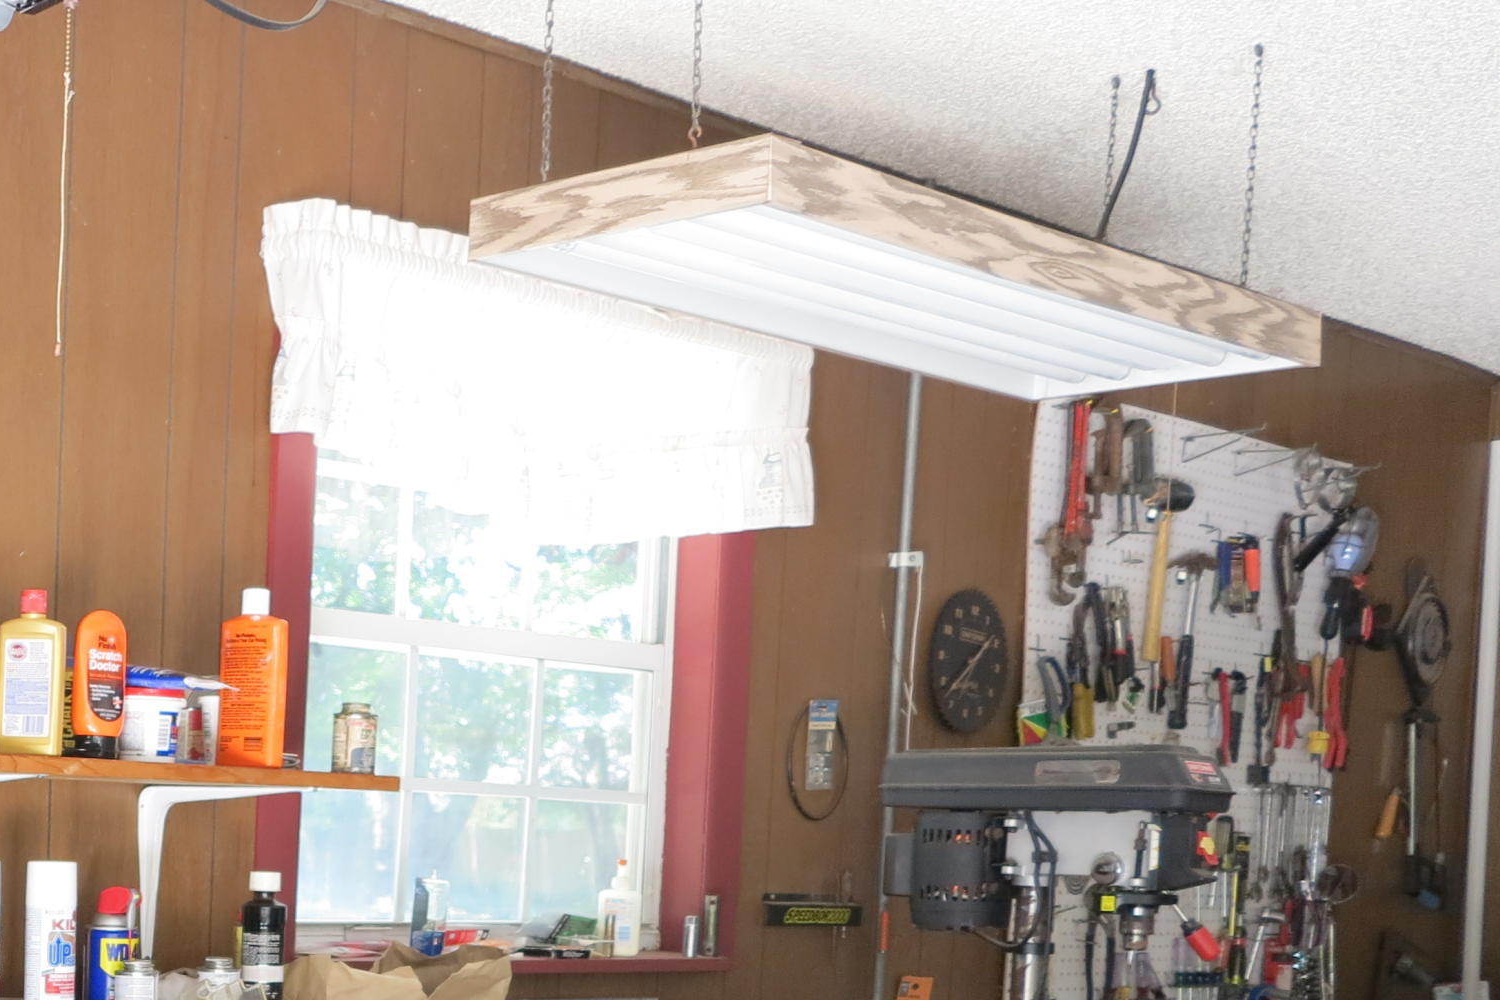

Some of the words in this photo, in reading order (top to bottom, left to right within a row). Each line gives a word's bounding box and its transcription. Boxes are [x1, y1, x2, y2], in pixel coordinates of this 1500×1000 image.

[88, 648, 123, 662] Scratch
[88, 660, 121, 672] Doctor
[52, 918, 76, 930] KIL
